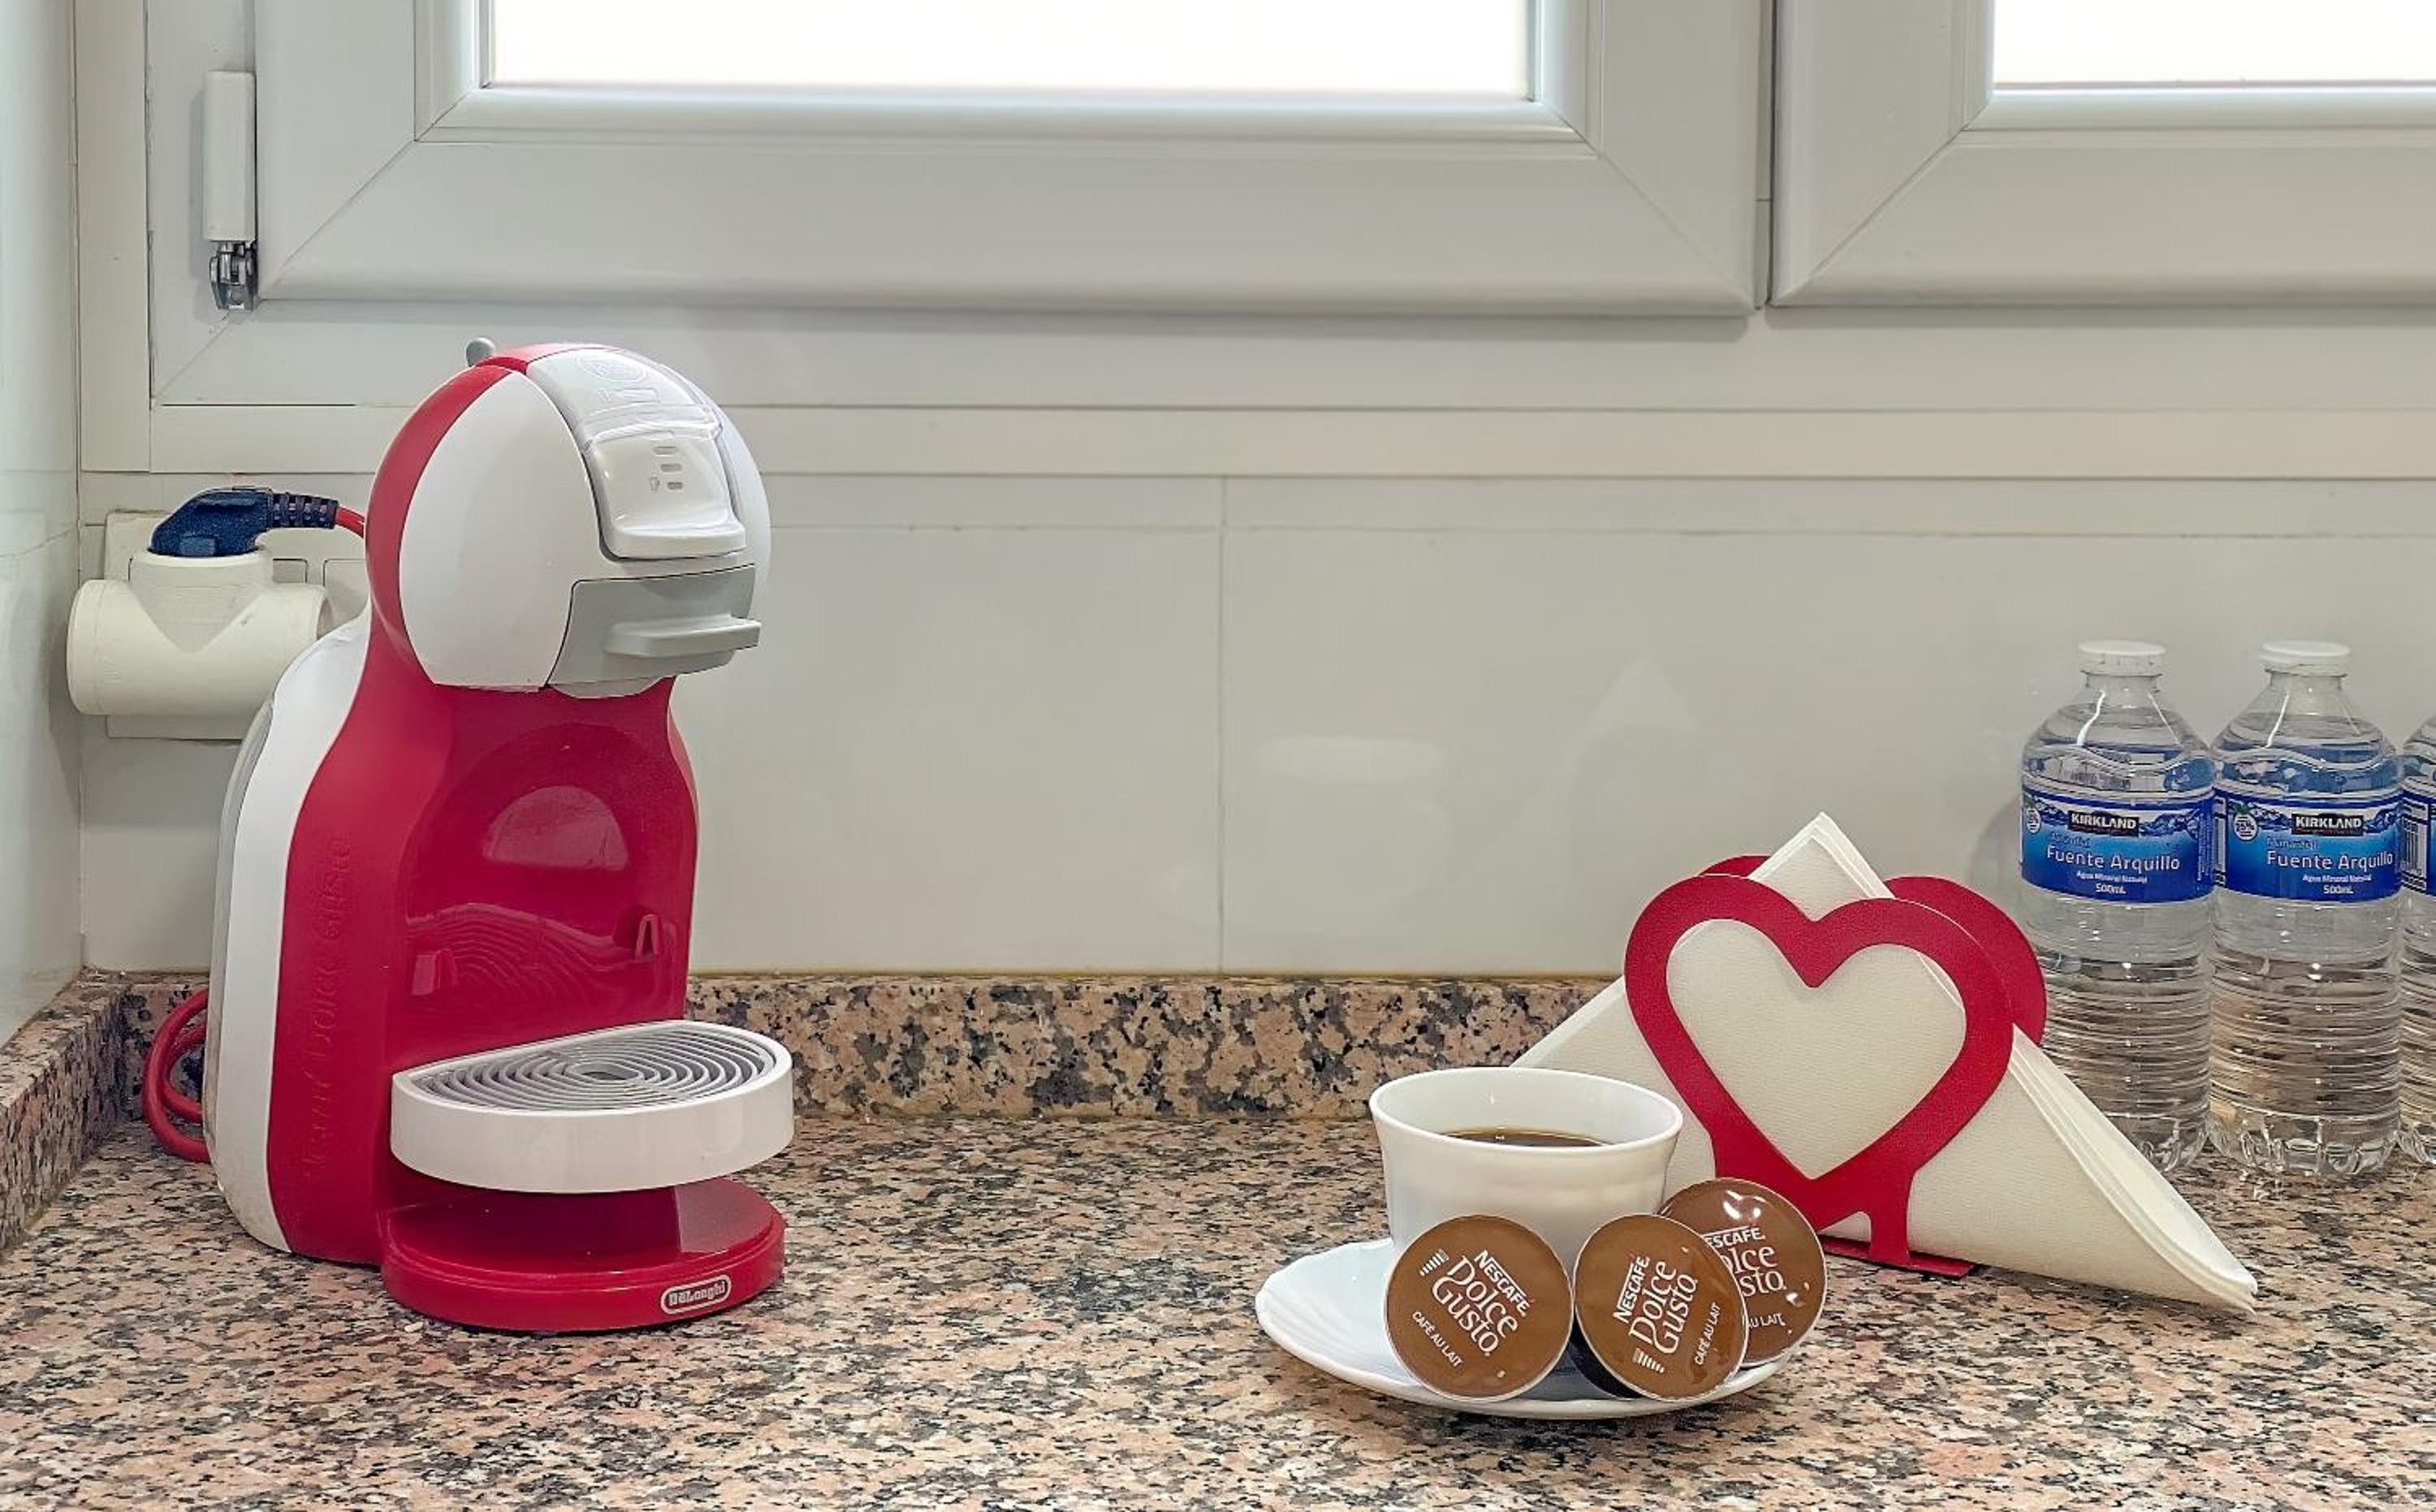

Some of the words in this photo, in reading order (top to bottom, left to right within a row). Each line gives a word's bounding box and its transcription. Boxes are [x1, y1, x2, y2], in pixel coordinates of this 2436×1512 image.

[2071, 813, 2136, 829] KIRKLAND
[2296, 816, 2362, 828] KIRKLAND
[2046, 845, 2105, 867] Fuente
[2110, 854, 2180, 874] Arquillo
[2266, 850, 2333, 870] Fuente
[2338, 853, 2393, 872] Arquillo
[1704, 1225, 1763, 1248] ESCAFÉ
[1447, 1255, 1518, 1338] Dolce
[1738, 1268, 1784, 1297] sto
[1628, 1261, 1677, 1345] Dolce
[1704, 1324, 1714, 1339] AU
[1710, 1302, 1721, 1325] LAIT
[1760, 1313, 1782, 1326] LAIT
[1412, 1311, 1436, 1336] CAFÉ
[1431, 1333, 1445, 1348] AU
[1441, 1345, 1463, 1367] LAIT
